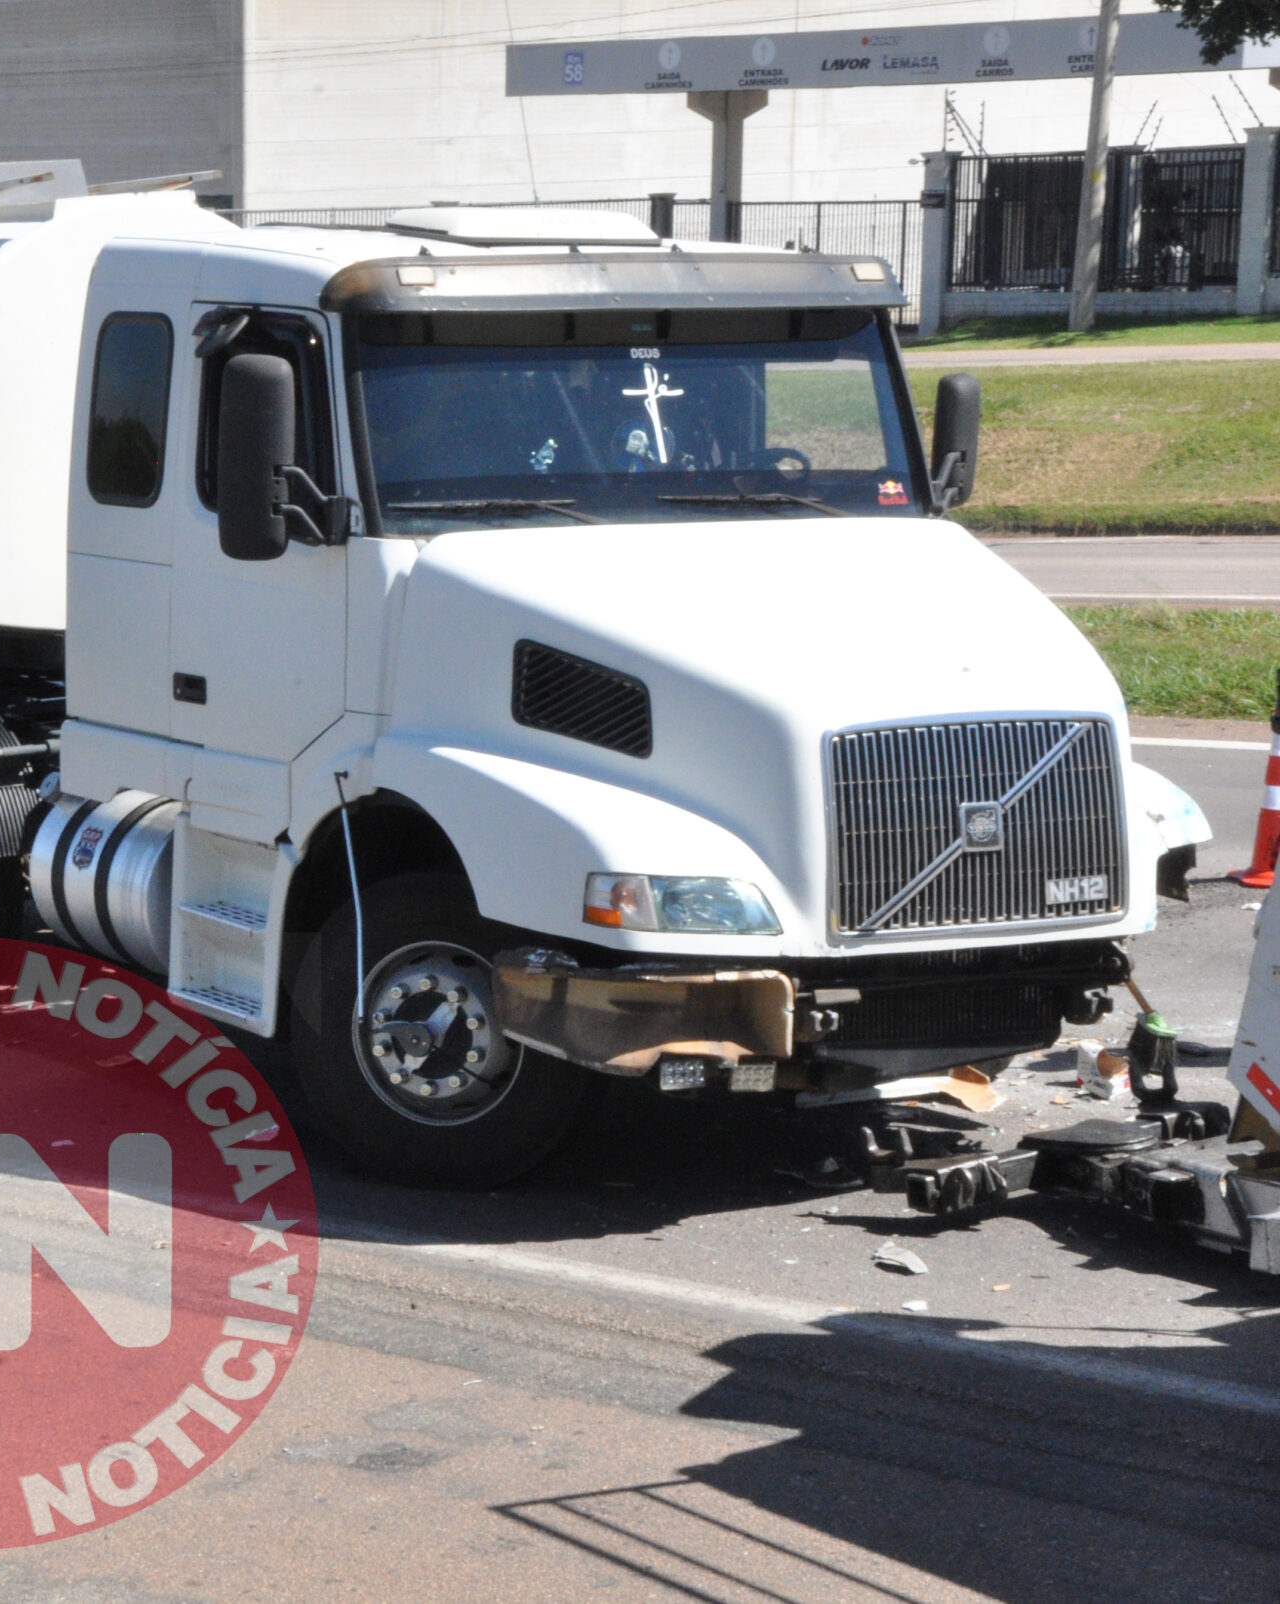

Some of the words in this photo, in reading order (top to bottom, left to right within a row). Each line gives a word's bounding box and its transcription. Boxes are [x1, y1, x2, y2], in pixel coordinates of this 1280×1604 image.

[820, 58, 870, 72] LAVOR
[882, 55, 939, 70] LEMASA
[1067, 54, 1094, 64] ENTR
[564, 64, 583, 82] 58
[743, 69, 784, 78] ENTRADA
[975, 67, 1014, 78] CARROS
[630, 347, 661, 359] DEUS
[1048, 876, 1105, 903] NH12
